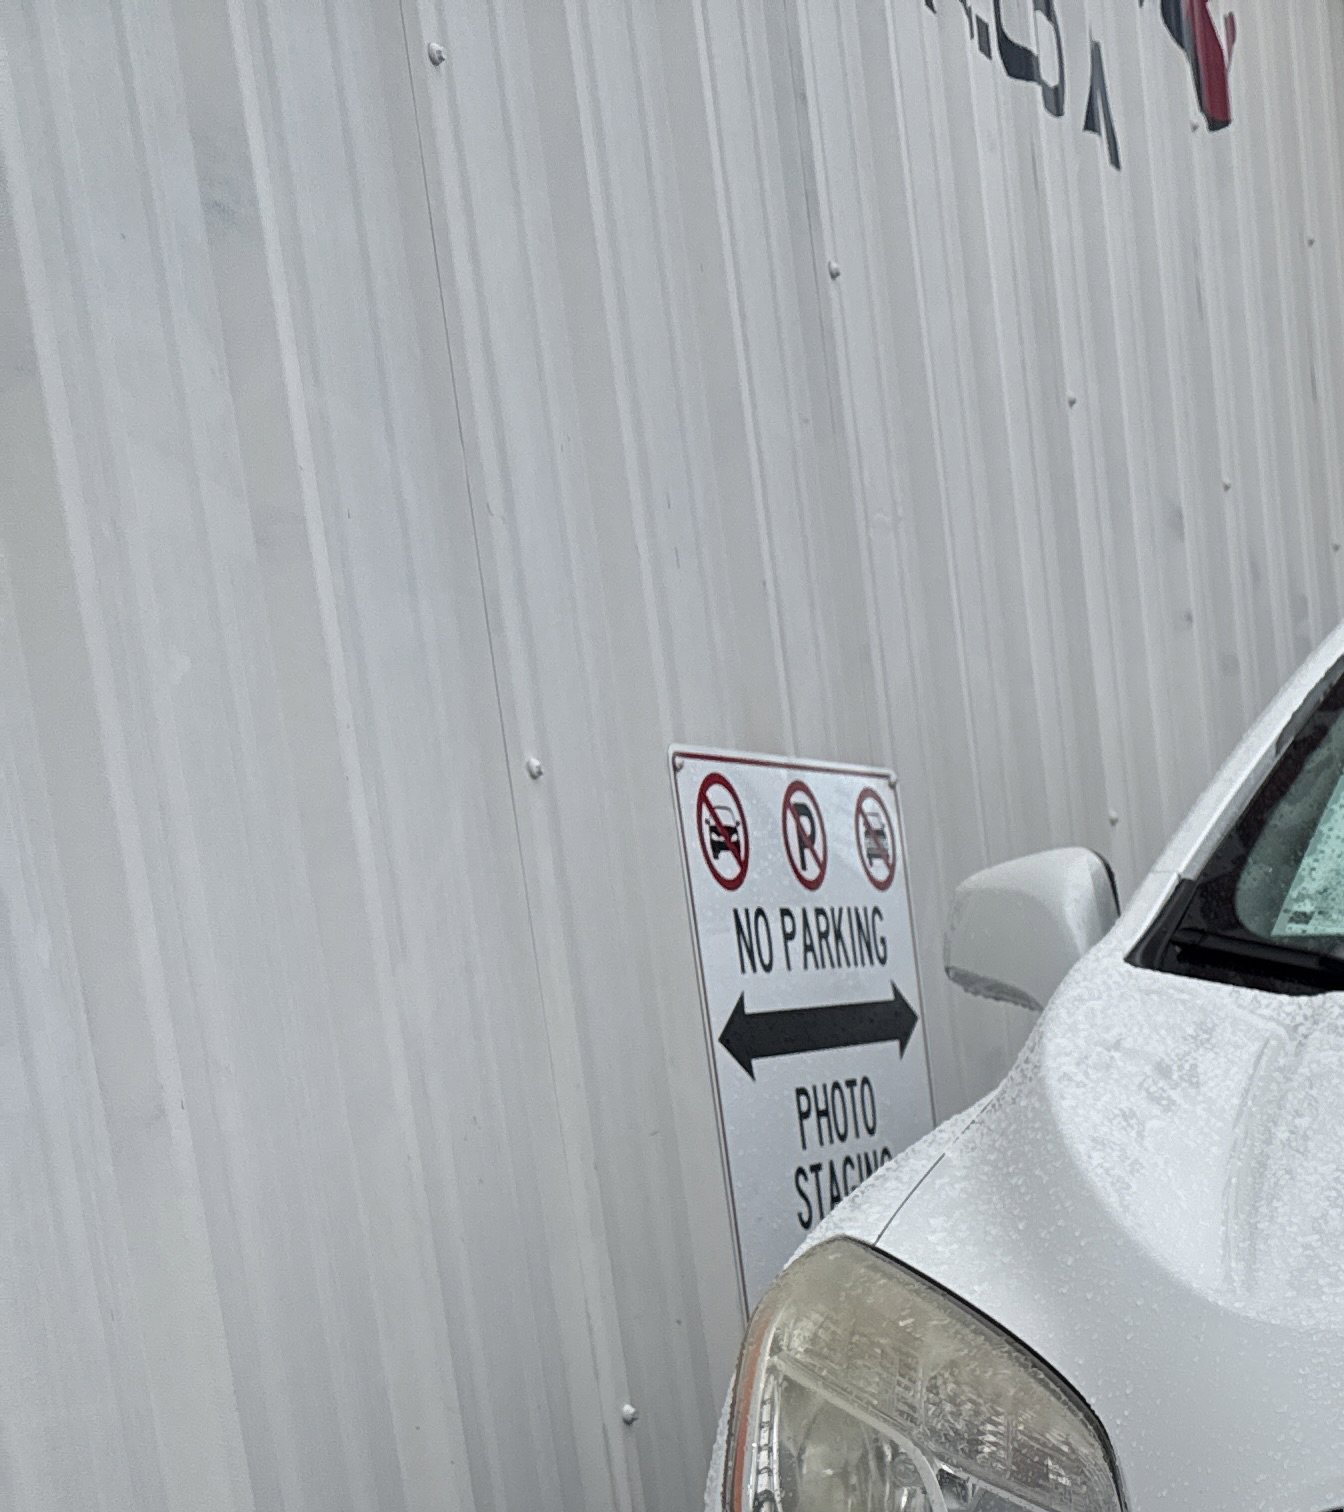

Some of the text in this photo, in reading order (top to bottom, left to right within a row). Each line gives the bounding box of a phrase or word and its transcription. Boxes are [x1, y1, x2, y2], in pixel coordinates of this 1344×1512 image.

[732, 905, 888, 975] NO PARKING
[795, 1074, 877, 1150] PHOTO
[794, 1145, 893, 1231] STAGI
